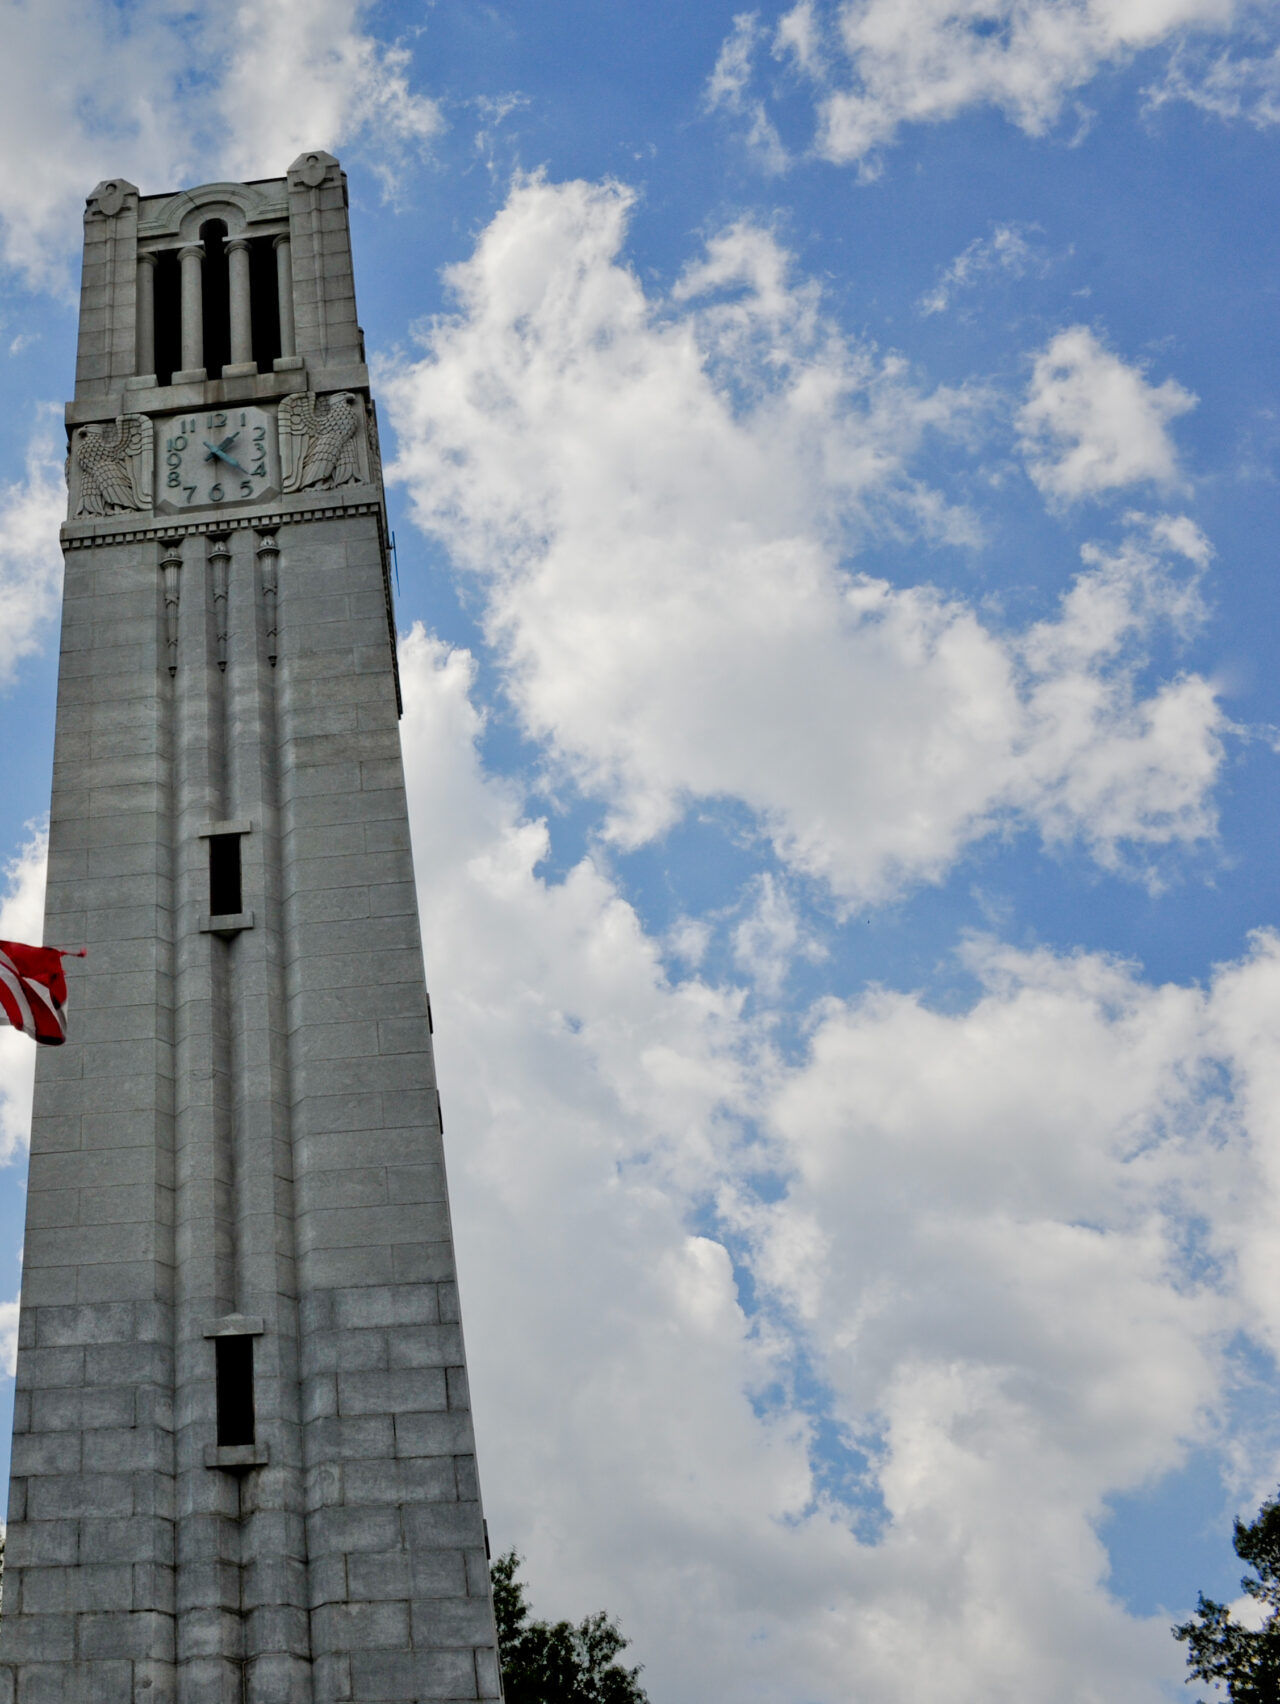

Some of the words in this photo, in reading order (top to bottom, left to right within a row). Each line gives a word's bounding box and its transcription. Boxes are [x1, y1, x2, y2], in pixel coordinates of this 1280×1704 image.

[181, 418, 195, 434] 11
[207, 413, 228, 429] 12
[240, 412, 246, 427] 1
[252, 427, 266, 441] 2
[167, 436, 188, 452] 10
[251, 443, 266, 461] 3
[166, 452, 182, 471] 9
[250, 461, 267, 477] 4
[167, 471, 181, 488] 8
[183, 485, 197, 504] 7
[208, 482, 225, 502] 6
[240, 480, 254, 498] 5
